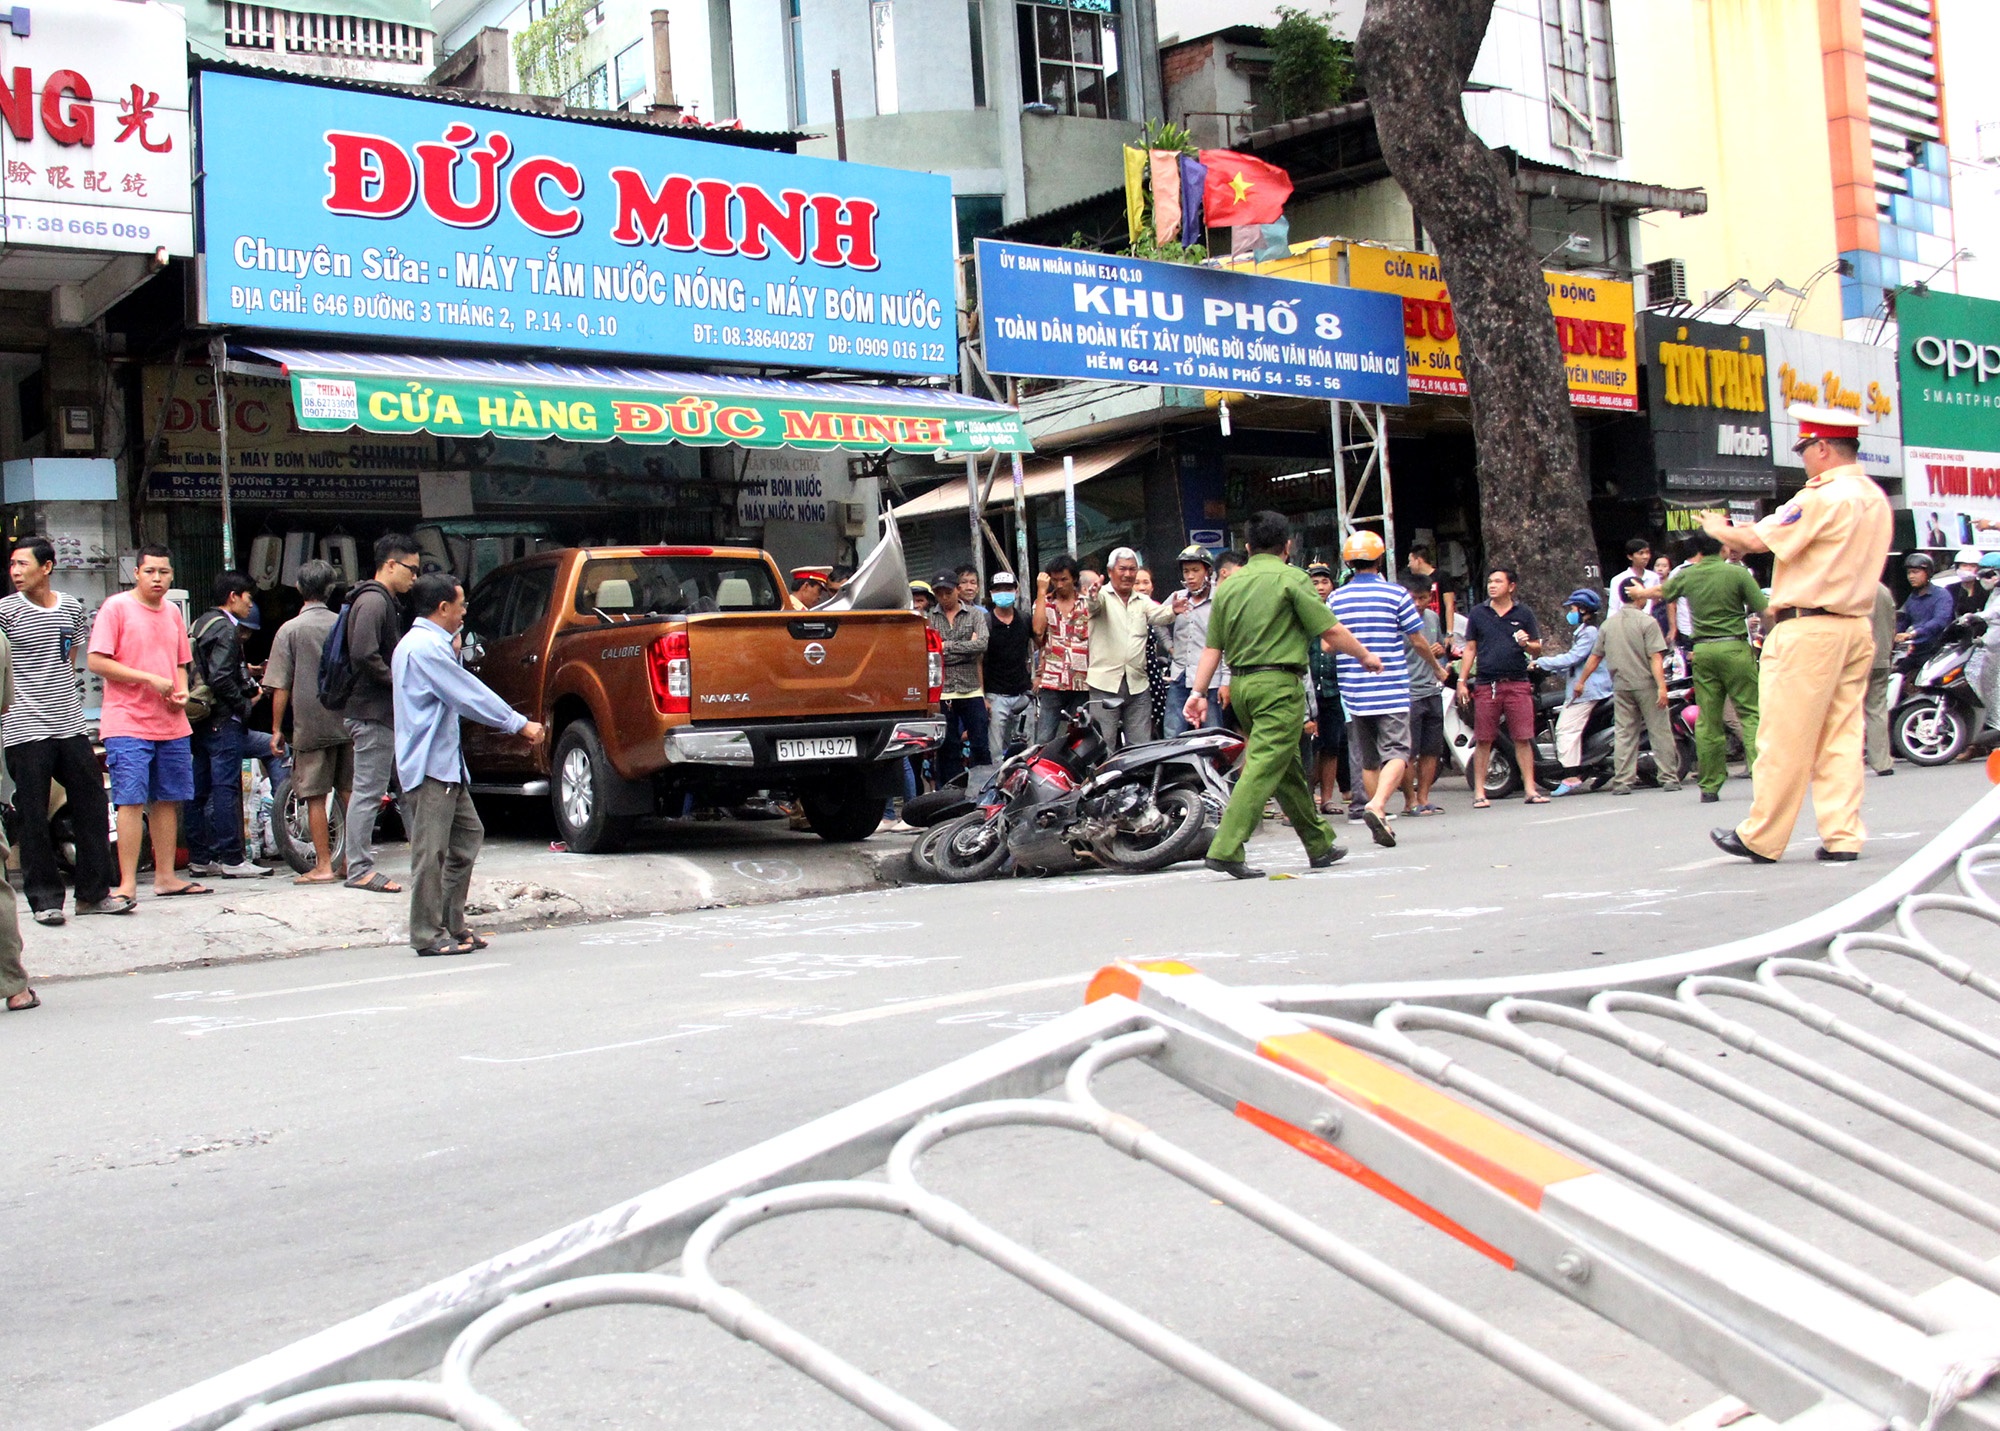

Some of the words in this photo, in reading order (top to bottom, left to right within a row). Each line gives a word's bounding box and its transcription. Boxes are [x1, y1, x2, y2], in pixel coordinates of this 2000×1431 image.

[114, 83, 172, 153] 光
[322, 121, 584, 237] ĐỨC
[609, 166, 880, 270] MINH
[37, 217, 64, 232] 38
[68, 220, 108, 236] 665
[113, 223, 150, 239] 089
[1018, 256, 1041, 272] BAN
[1043, 257, 1072, 275] NHÂN
[1074, 260, 1096, 278] DÂN
[1385, 255, 1414, 278] CỬA
[233, 235, 351, 280] Chuyên
[362, 246, 430, 284] Sửa:
[455, 245, 519, 292] MÁY
[526, 246, 585, 299] TẮM
[594, 259, 666, 303] NƯỚC
[673, 266, 746, 313] NÓNG
[766, 276, 819, 319] MÁY
[824, 284, 875, 324] BƠM
[880, 289, 942, 330] NƯỚC
[1560, 282, 1596, 304] ĐỘNG
[231, 286, 264, 315] ĐỊA
[269, 284, 307, 313] CHỈ:
[312, 292, 347, 316] 646
[353, 291, 415, 322] ĐƯỜNG
[420, 301, 432, 322] 3
[436, 299, 494, 327] THÁNG
[499, 307, 515, 333] 2,
[525, 309, 562, 333] P.14
[577, 315, 618, 338] Q.10
[1073, 282, 1184, 322] KHU
[1203, 298, 1302, 335] PHỐ
[1315, 312, 1343, 340] 8
[693, 323, 718, 344] ĐT:
[722, 326, 815, 351] 08.38640287
[855, 337, 888, 358] 0909
[892, 341, 917, 360] 016
[921, 342, 945, 362] 122
[995, 314, 1037, 341] TOÀN
[1041, 317, 1073, 344] DÂN
[1077, 321, 1117, 347] ĐOÀN
[1120, 322, 1148, 350] KẾT
[1153, 327, 1180, 353] XÂY
[1184, 331, 1219, 358] DỰNG
[1222, 335, 1244, 360] ĐỜI
[1247, 336, 1280, 364] SỐNG
[1281, 344, 1306, 366] VĂN
[1308, 345, 1333, 368] HÓA
[1335, 351, 1357, 371] KHU
[1360, 351, 1383, 374] DÂN
[1385, 355, 1400, 376] CƯ
[1429, 347, 1451, 370] SỬA
[1086, 351, 1124, 371] HẺM
[1128, 359, 1158, 374] 644
[1173, 358, 1194, 376] TỔ
[1198, 362, 1228, 380] DÂN
[1232, 366, 1261, 383] PHỐ
[1265, 371, 1282, 385] 54
[1295, 374, 1312, 387] 55
[1323, 376, 1341, 390] 56
[1591, 368, 1627, 391] NGHIỆP
[369, 381, 464, 425] CỬA
[479, 390, 598, 431] HÀNG
[611, 395, 766, 440] ĐỨC
[779, 409, 952, 447] MINH
[1717, 424, 1768, 457] Mobile
[241, 448, 269, 468] MÁY
[795, 474, 822, 497] NƯỚC
[798, 500, 825, 521] NÓNG
[601, 645, 641, 660] CALIBRE
[700, 692, 750, 704] NAVARA
